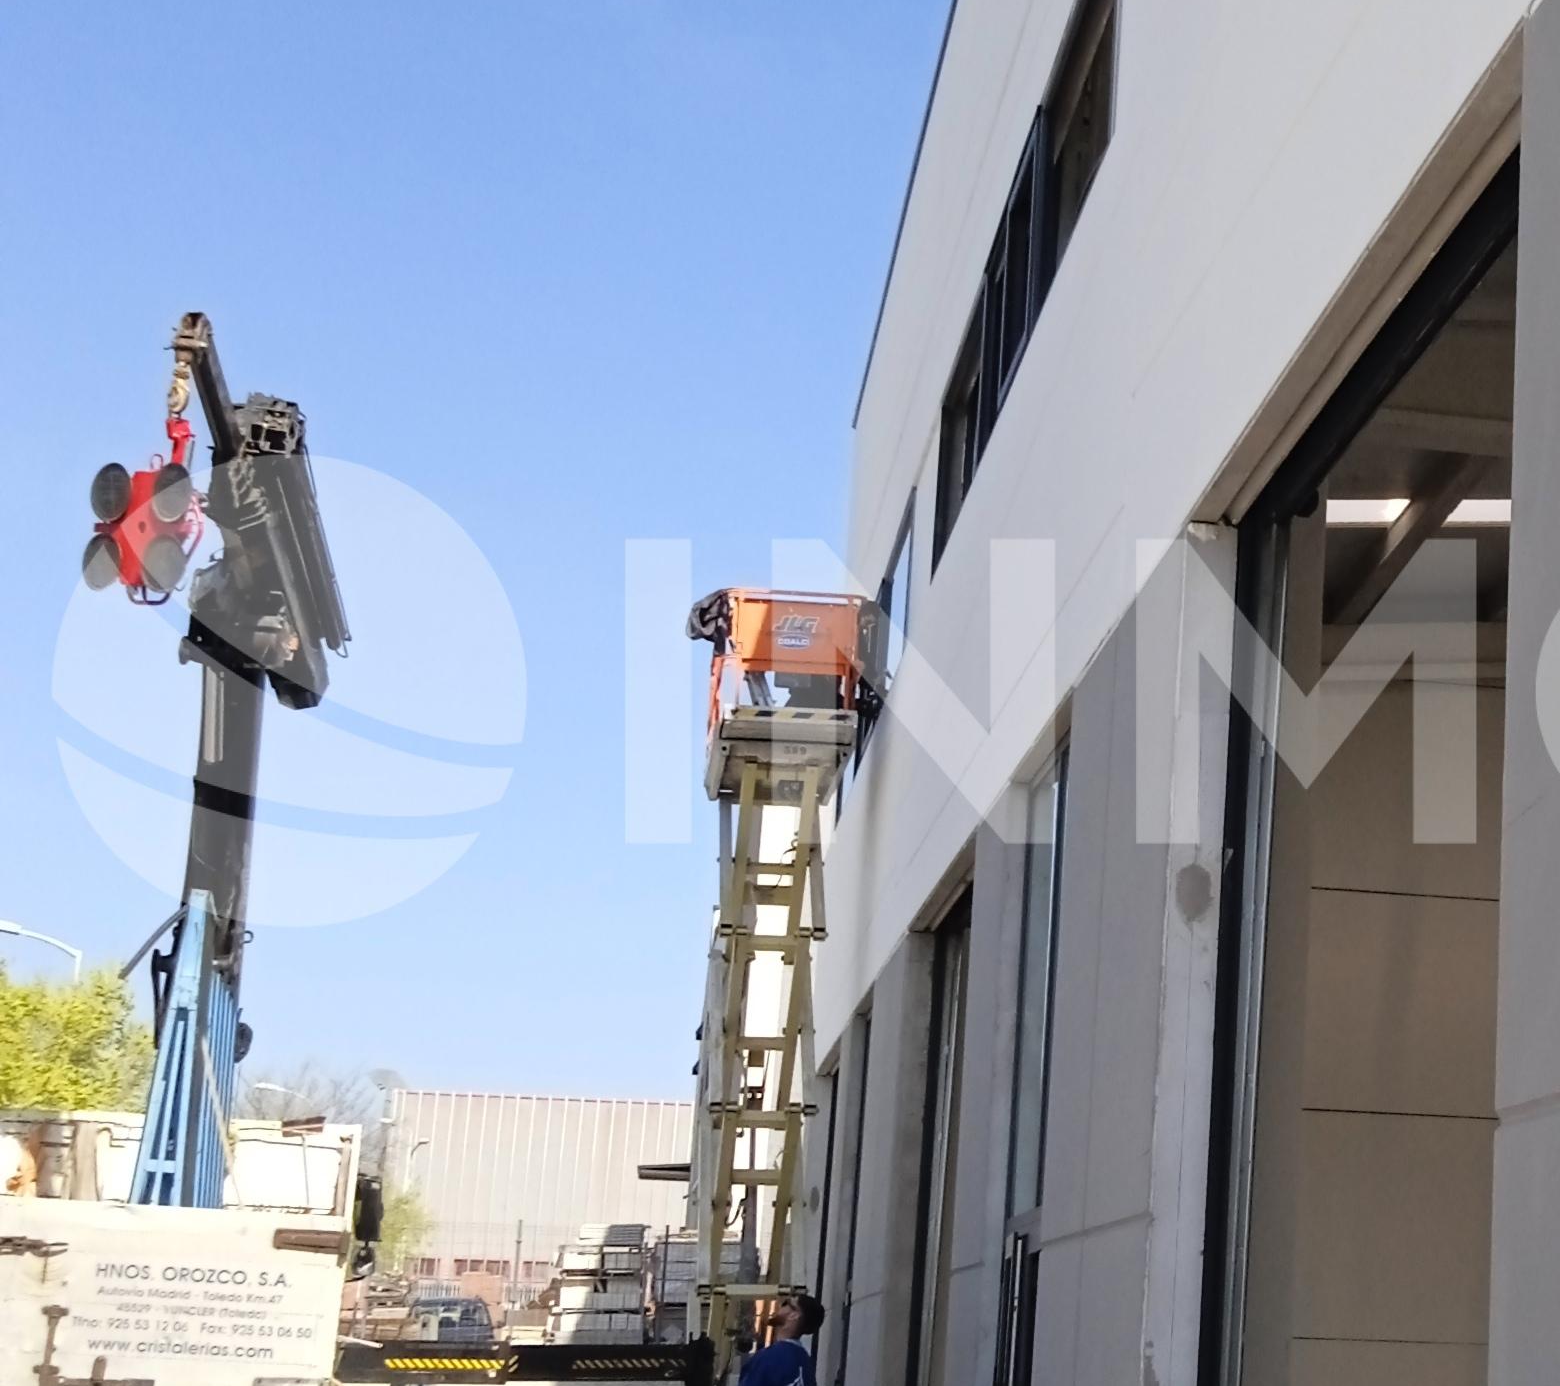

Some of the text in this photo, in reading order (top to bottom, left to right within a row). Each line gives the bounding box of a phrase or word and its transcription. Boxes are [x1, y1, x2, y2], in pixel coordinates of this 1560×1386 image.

[773, 615, 820, 633] JLG
[96, 1263, 154, 1280] HNOS.
[257, 1271, 293, 1288] S.A.
[147, 1288, 192, 1300] Madrid
[203, 1291, 243, 1302] Toledo
[106, 1317, 131, 1331] 925
[133, 1318, 151, 1332] 53
[155, 1320, 170, 1332] 12
[172, 1321, 189, 1333] 06
[231, 1324, 256, 1337] 925
[257, 1325, 274, 1338] 53
[276, 1326, 293, 1339] 06
